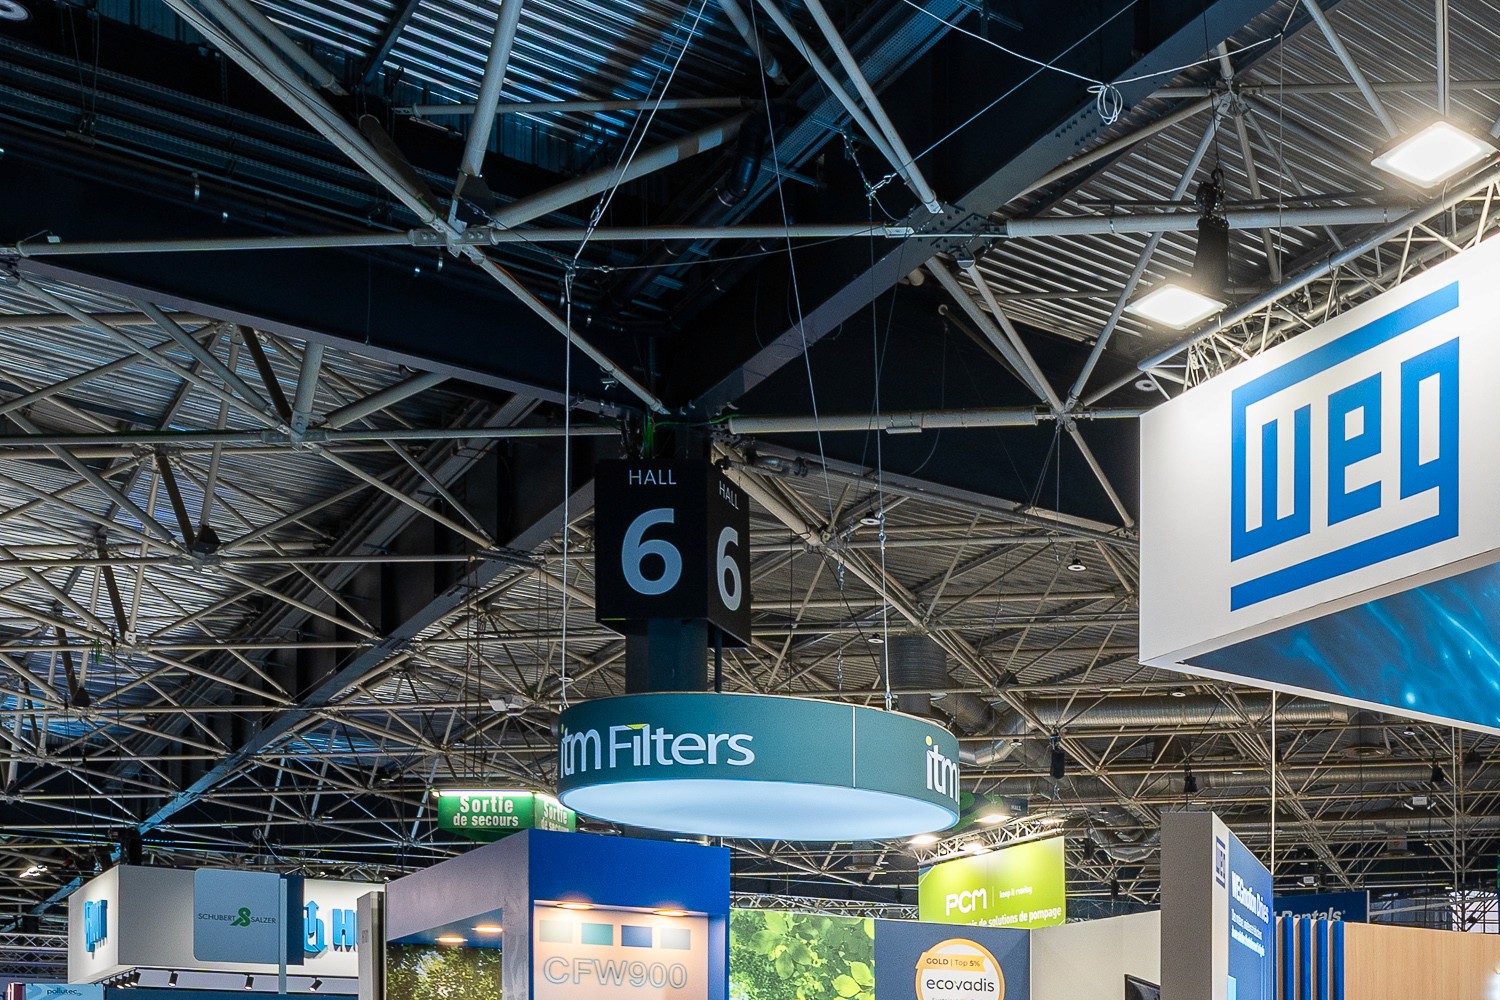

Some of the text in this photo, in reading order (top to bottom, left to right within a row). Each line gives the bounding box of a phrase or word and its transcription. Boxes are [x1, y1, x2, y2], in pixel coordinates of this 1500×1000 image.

[629, 469, 677, 485] HALL
[719, 480, 740, 511] HALL
[621, 507, 683, 596] 6
[716, 526, 743, 612] 6
[609, 723, 755, 768] Filters
[459, 795, 514, 814] Sortie
[543, 801, 568, 825] Sortie
[453, 813, 519, 827] de secours
[945, 888, 987, 916] PCM
[198, 912, 276, 925] SCHUBERT SALZER
[988, 914, 1018, 926] solutions
[1018, 910, 1028, 921] de
[1028, 906, 1062, 922] pompage
[926, 957, 949, 965] GOLD
[955, 959, 968, 967] Top
[543, 956, 688, 989] CFW900
[46, 987, 78, 997] pollutec
[926, 978, 995, 992] ecovadis
